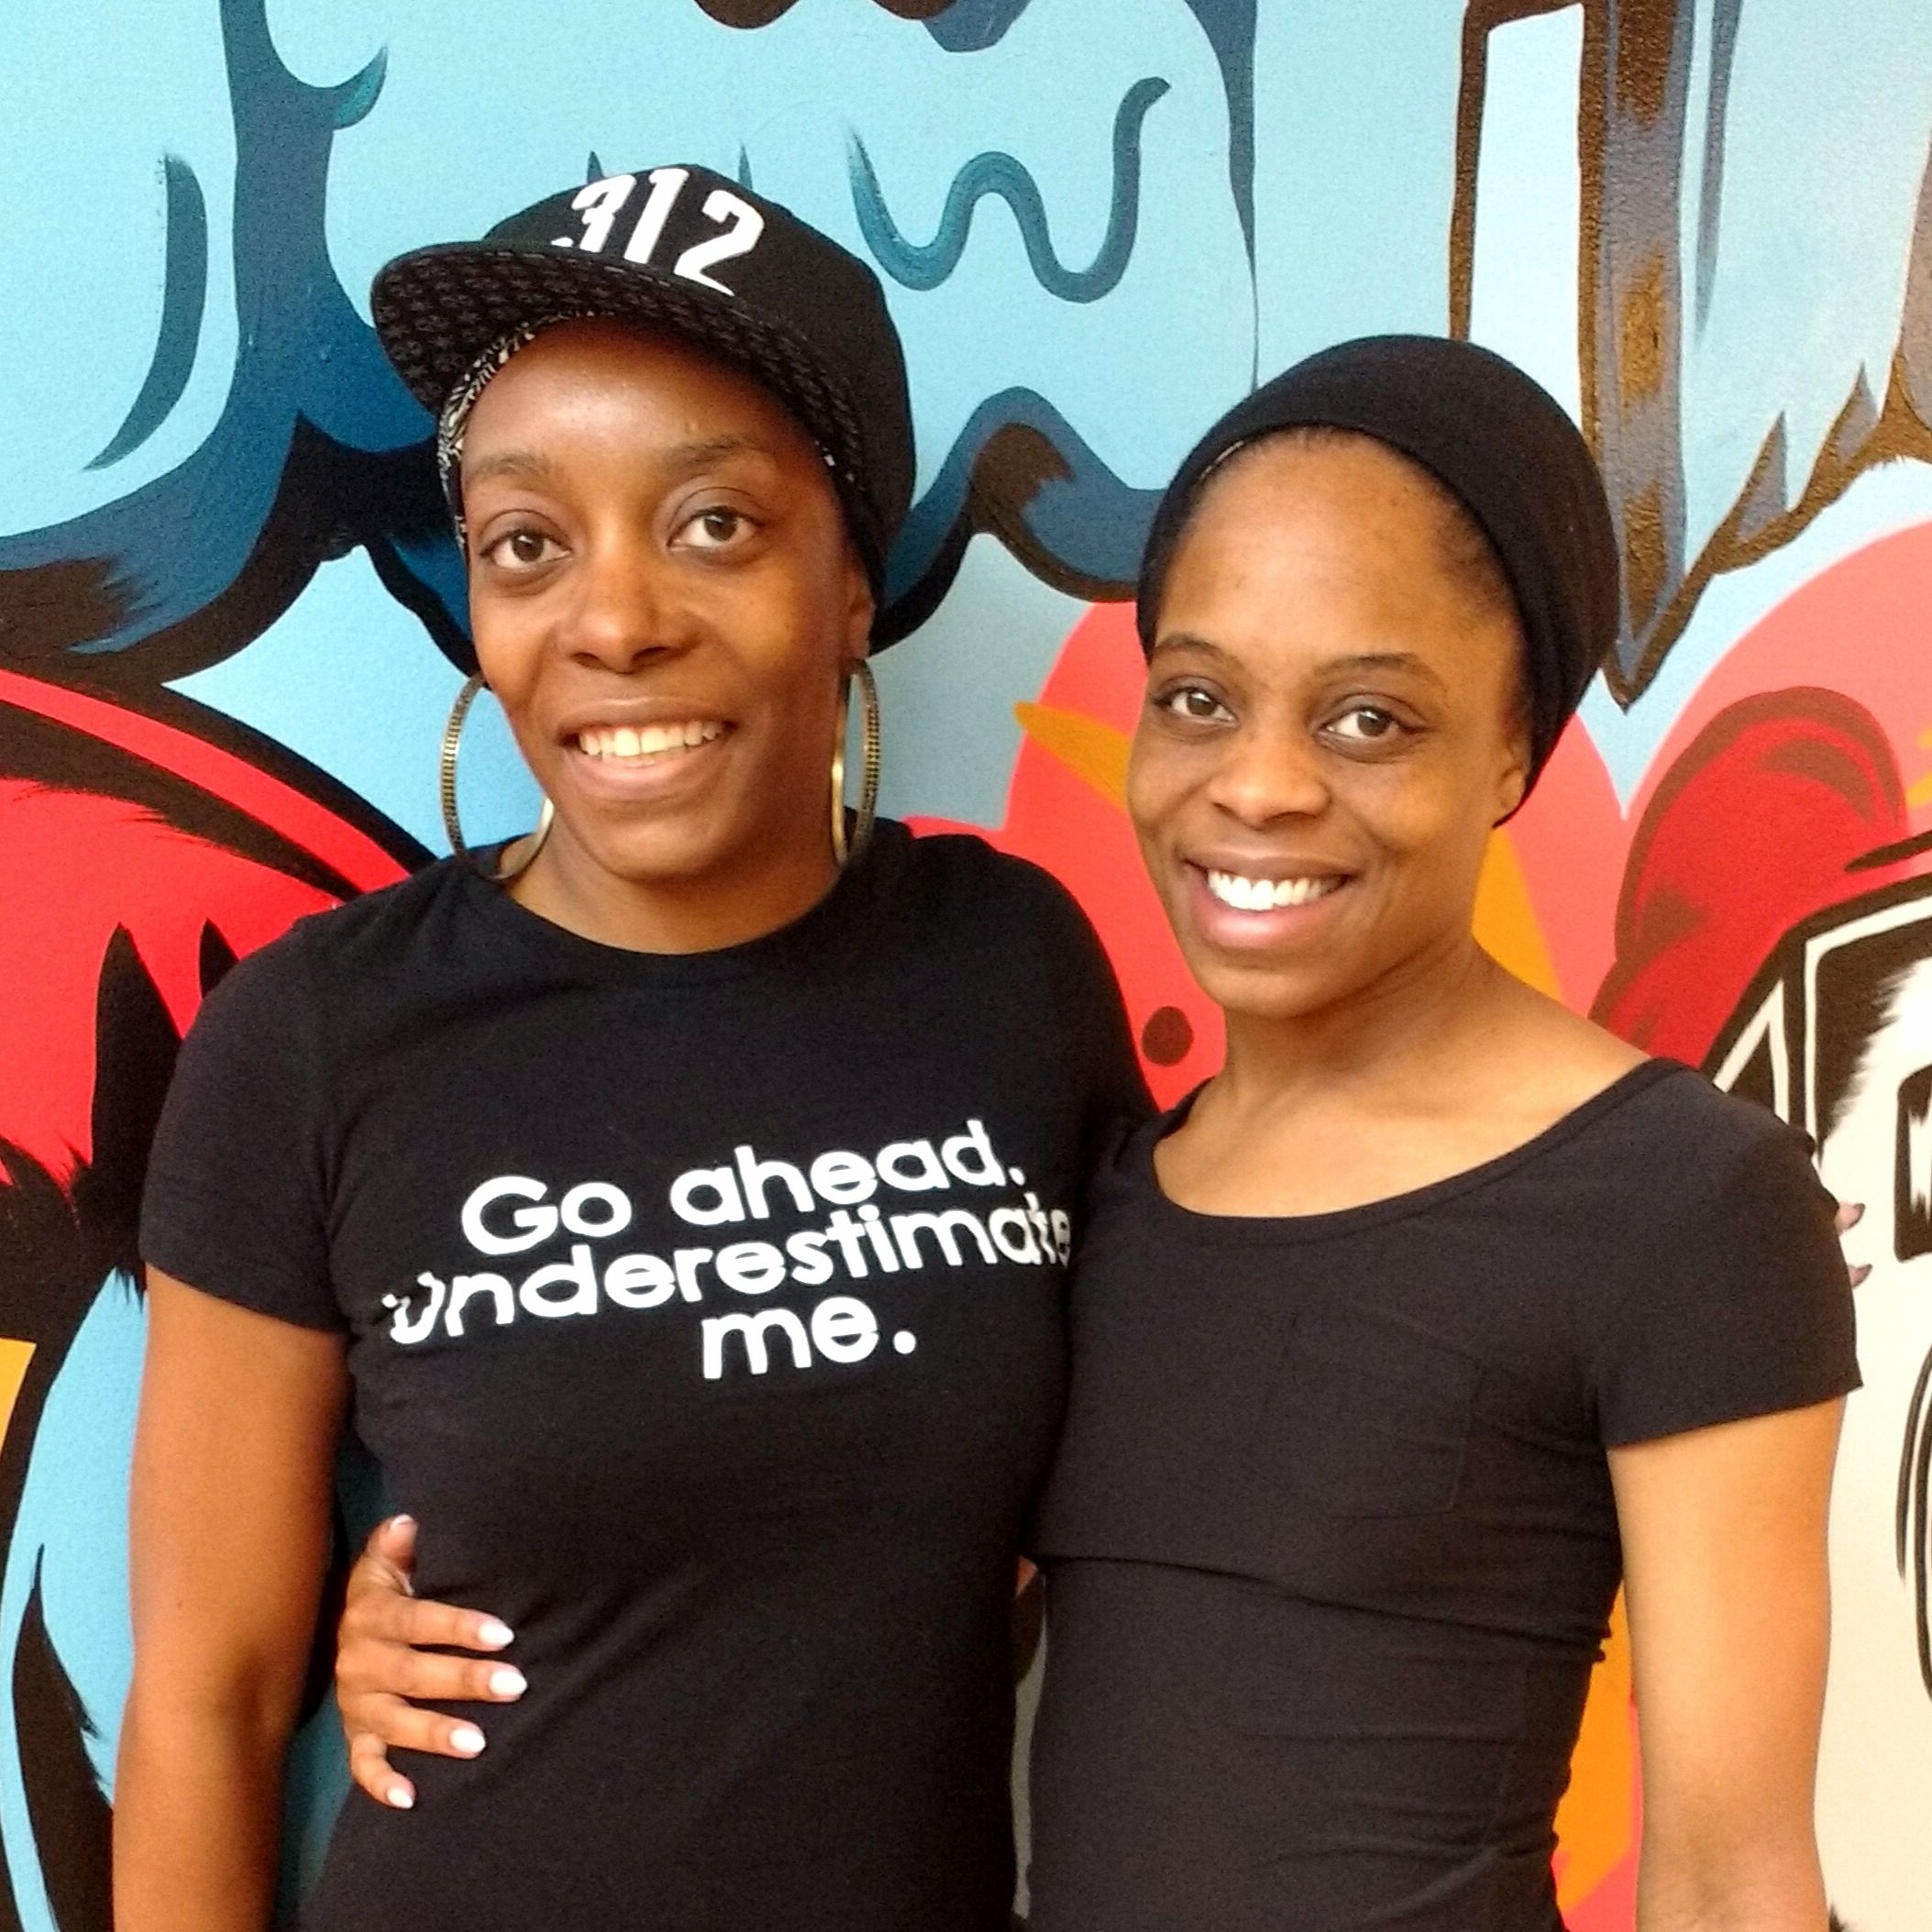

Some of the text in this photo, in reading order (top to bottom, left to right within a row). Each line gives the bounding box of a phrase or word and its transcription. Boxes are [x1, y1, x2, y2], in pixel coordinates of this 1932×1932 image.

[550, 168, 765, 296] 312
[461, 1120, 1026, 1255] Go ahead.
[701, 1297, 917, 1380] me.
